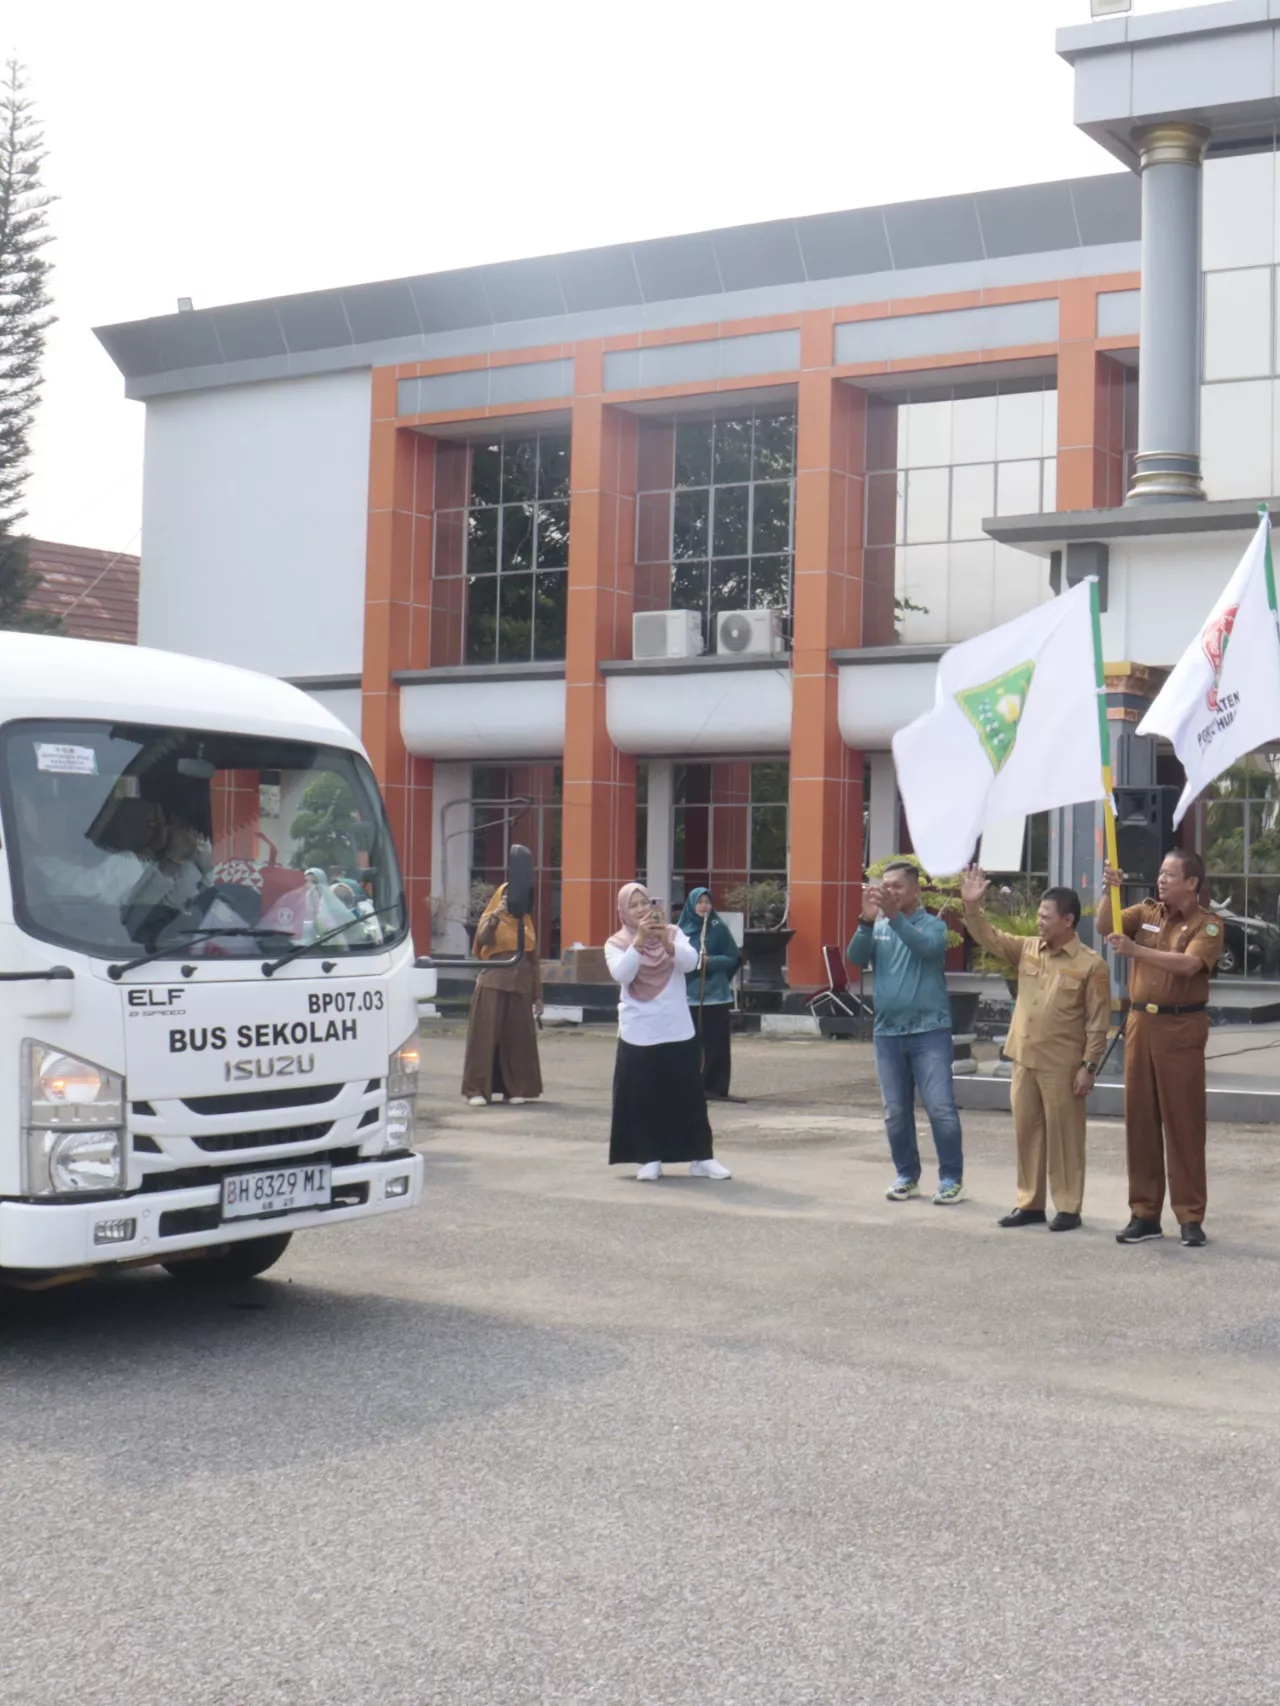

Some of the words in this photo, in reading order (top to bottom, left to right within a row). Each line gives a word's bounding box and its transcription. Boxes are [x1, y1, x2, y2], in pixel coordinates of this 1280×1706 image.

[1215, 691, 1241, 714] ATEN
[127, 988, 185, 1006] ELF
[308, 990, 384, 1014] BP07.03
[169, 1026, 227, 1053] BUS
[237, 1018, 358, 1048] SEKOLAH
[224, 1053, 316, 1082] ISUZU
[227, 1179, 249, 1204] BH
[254, 1172, 298, 1201] 8329
[303, 1168, 326, 1192] MI
